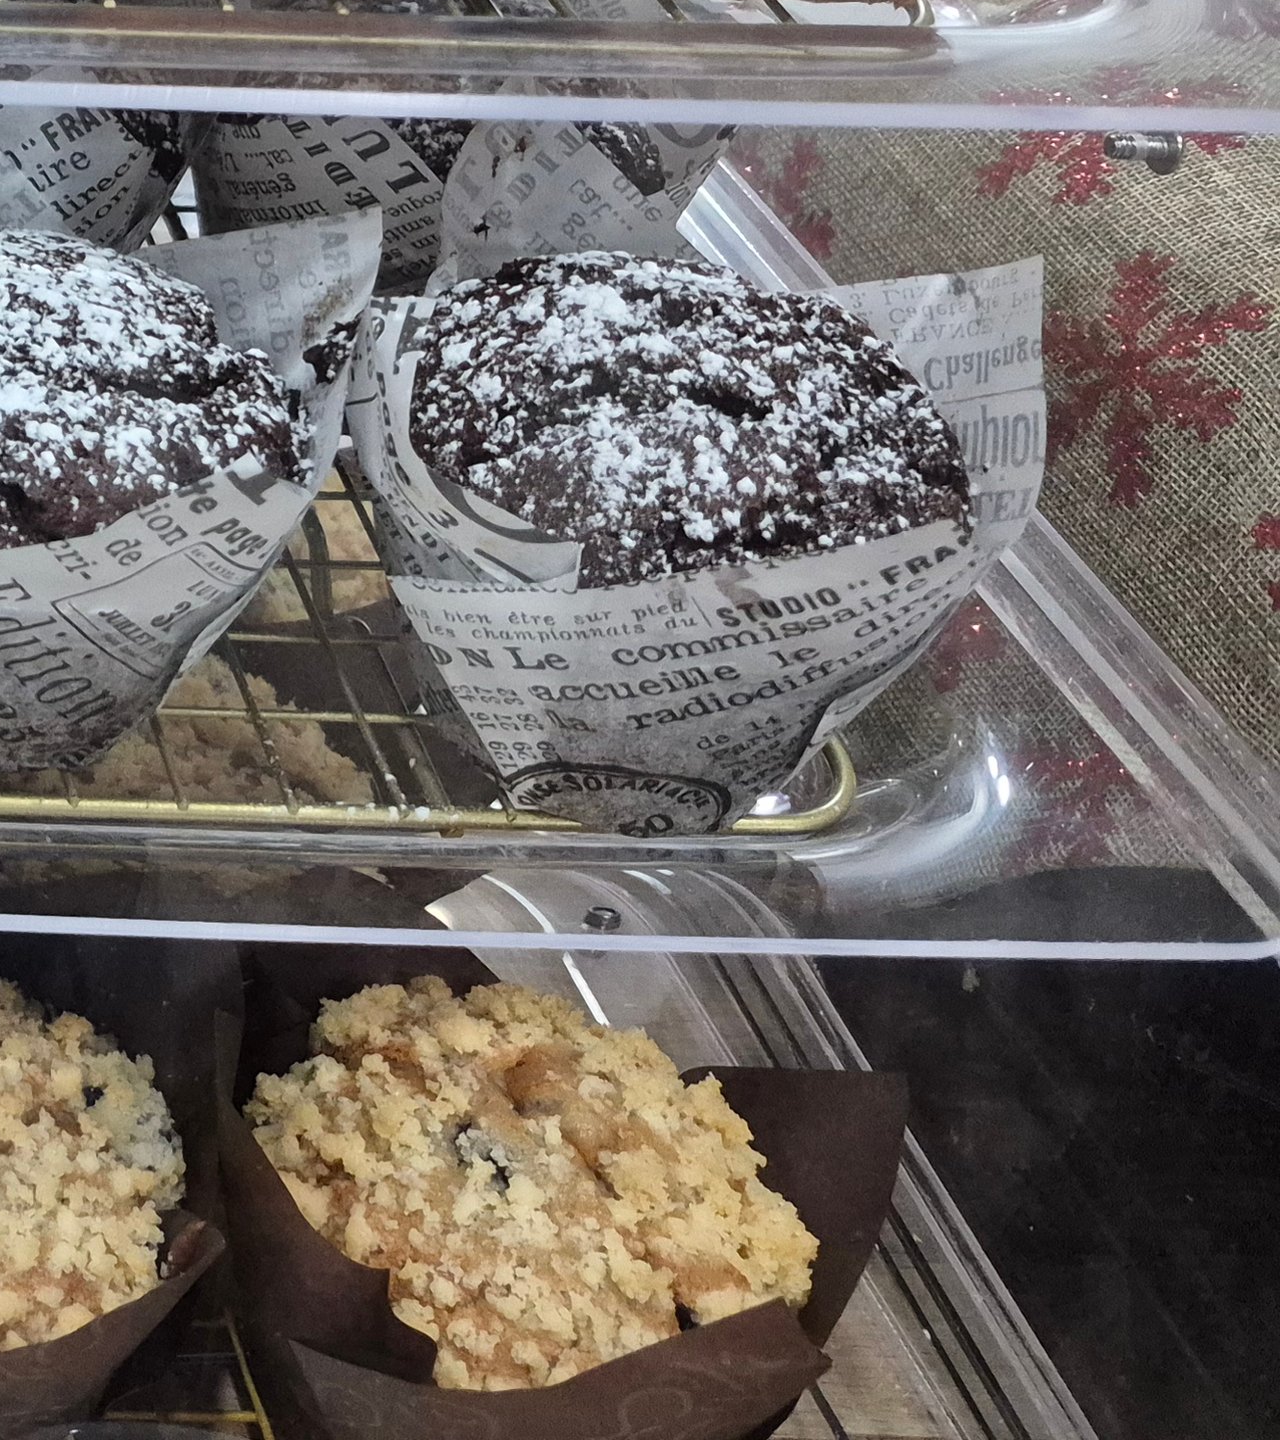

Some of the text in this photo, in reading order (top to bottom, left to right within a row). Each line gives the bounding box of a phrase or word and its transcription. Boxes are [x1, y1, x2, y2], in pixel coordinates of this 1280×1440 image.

[105, 538, 142, 567] de
[443, 609, 492, 625] bien
[507, 609, 556, 626] être
[573, 609, 612, 625] sur
[715, 586, 842, 628] STUDIO
[471, 622, 646, 644] championnats
[663, 617, 699, 630] du
[503, 646, 570, 670] Le
[528, 646, 821, 703] accueille le
